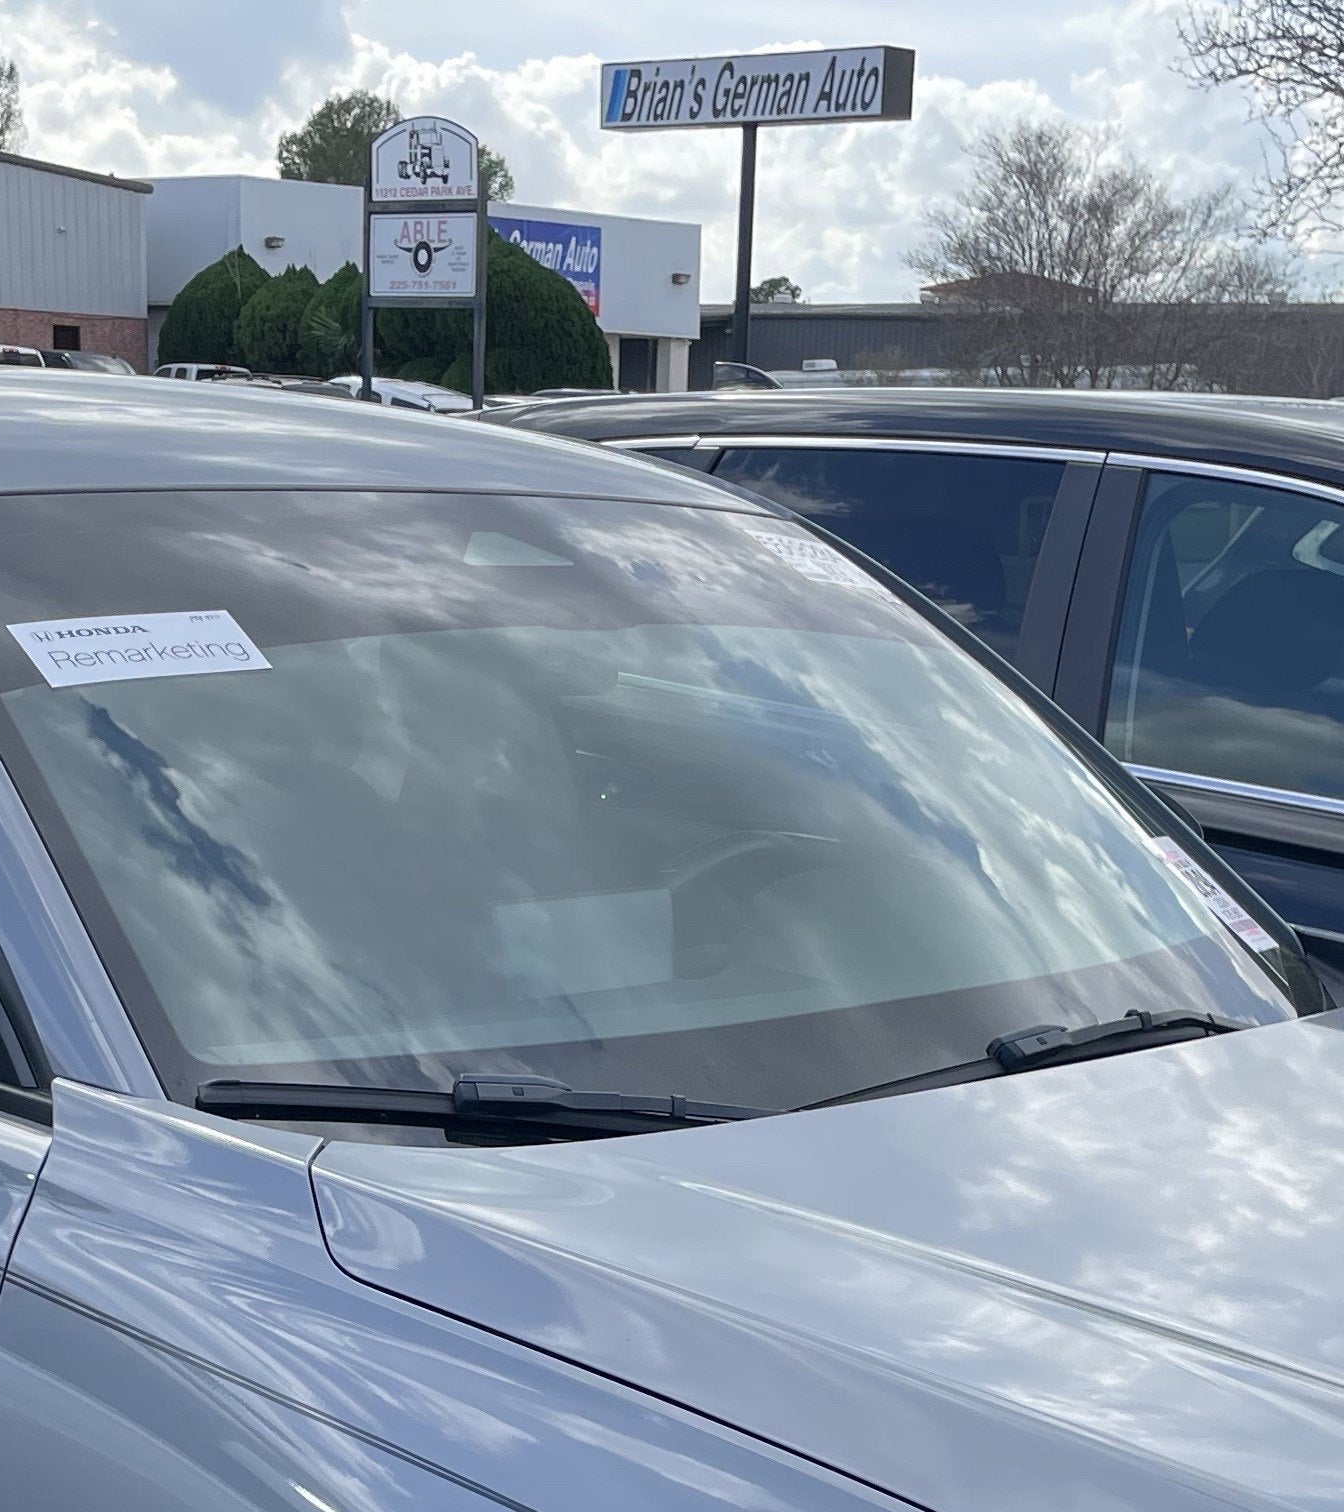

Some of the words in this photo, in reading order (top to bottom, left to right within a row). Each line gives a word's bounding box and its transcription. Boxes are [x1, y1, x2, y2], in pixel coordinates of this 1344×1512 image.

[620, 64, 706, 122] Brian's
[712, 61, 811, 118] German
[813, 56, 879, 113] Auto
[399, 220, 448, 244] ABLE
[562, 236, 598, 273] Auto
[56, 624, 150, 640] HONDA
[47, 640, 251, 669] Remarketing
